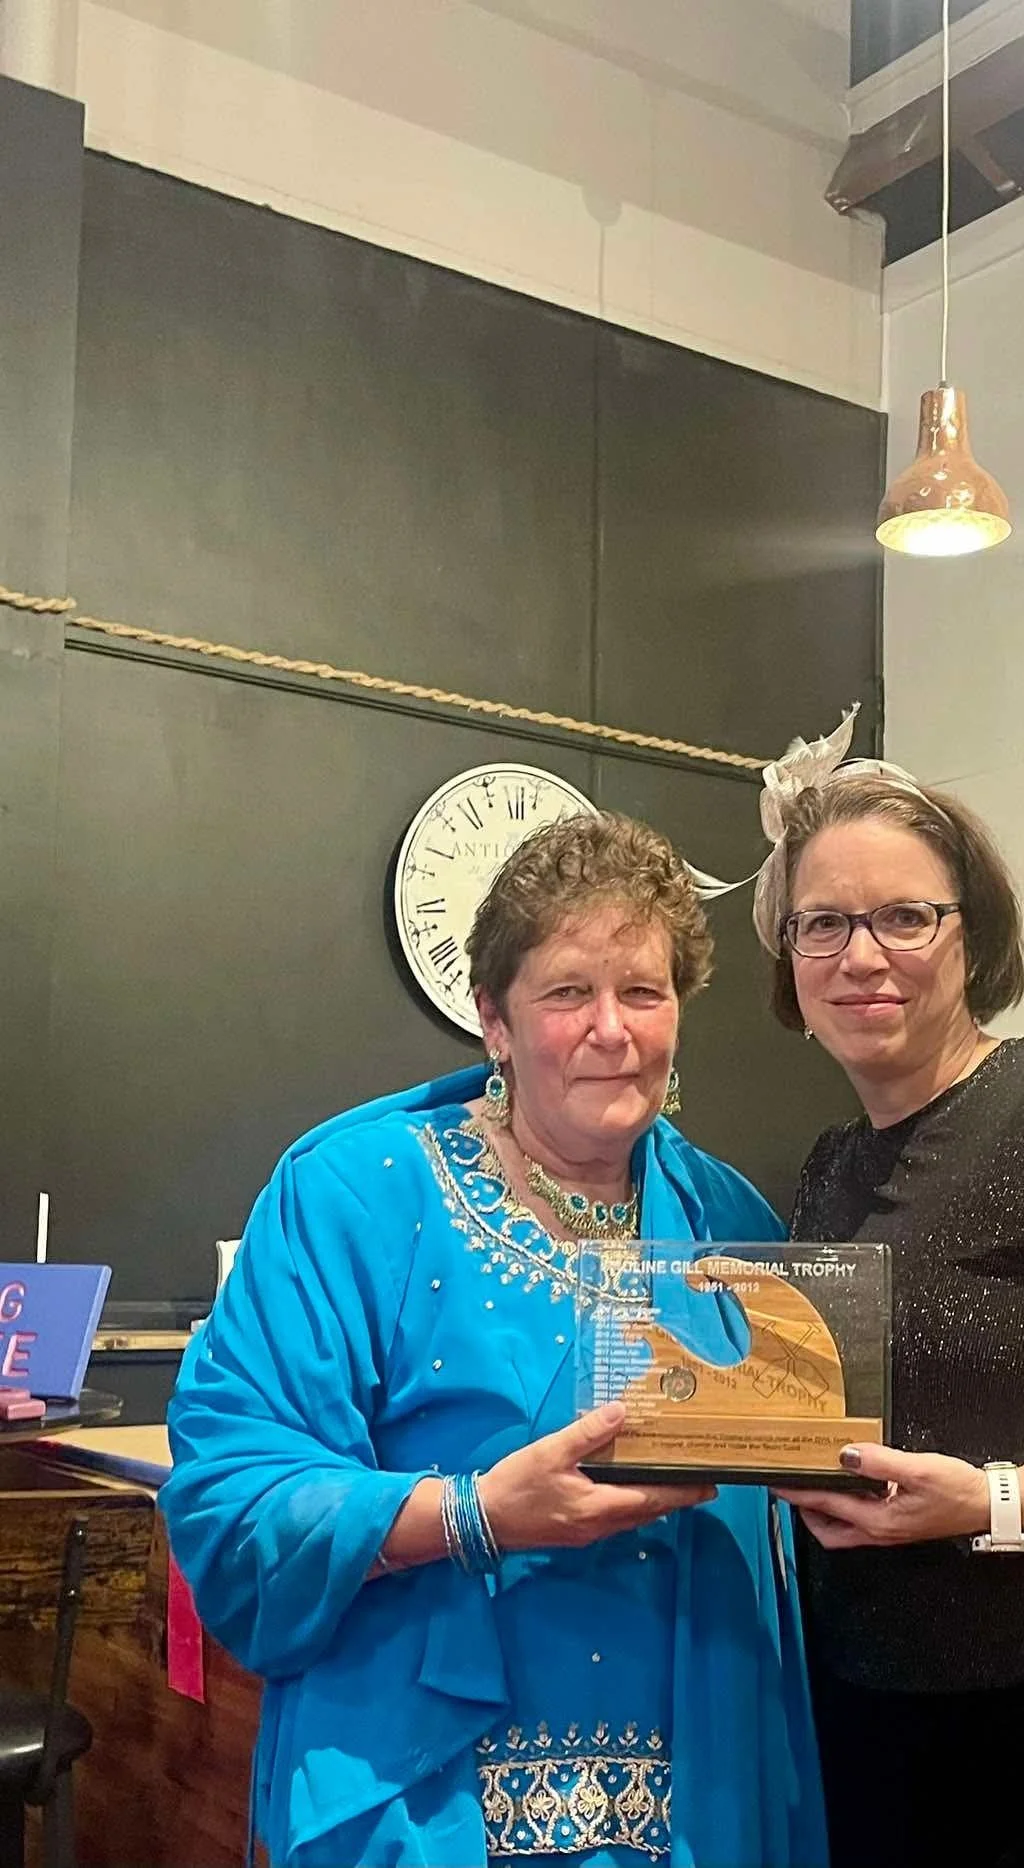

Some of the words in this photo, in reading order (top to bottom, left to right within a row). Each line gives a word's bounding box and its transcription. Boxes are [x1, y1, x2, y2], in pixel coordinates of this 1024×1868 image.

[670, 1260, 704, 1275] GILL
[706, 1261, 789, 1276] MEMORIAL
[792, 1262, 857, 1278] TROPHY
[733, 1282, 760, 1294] 2012
